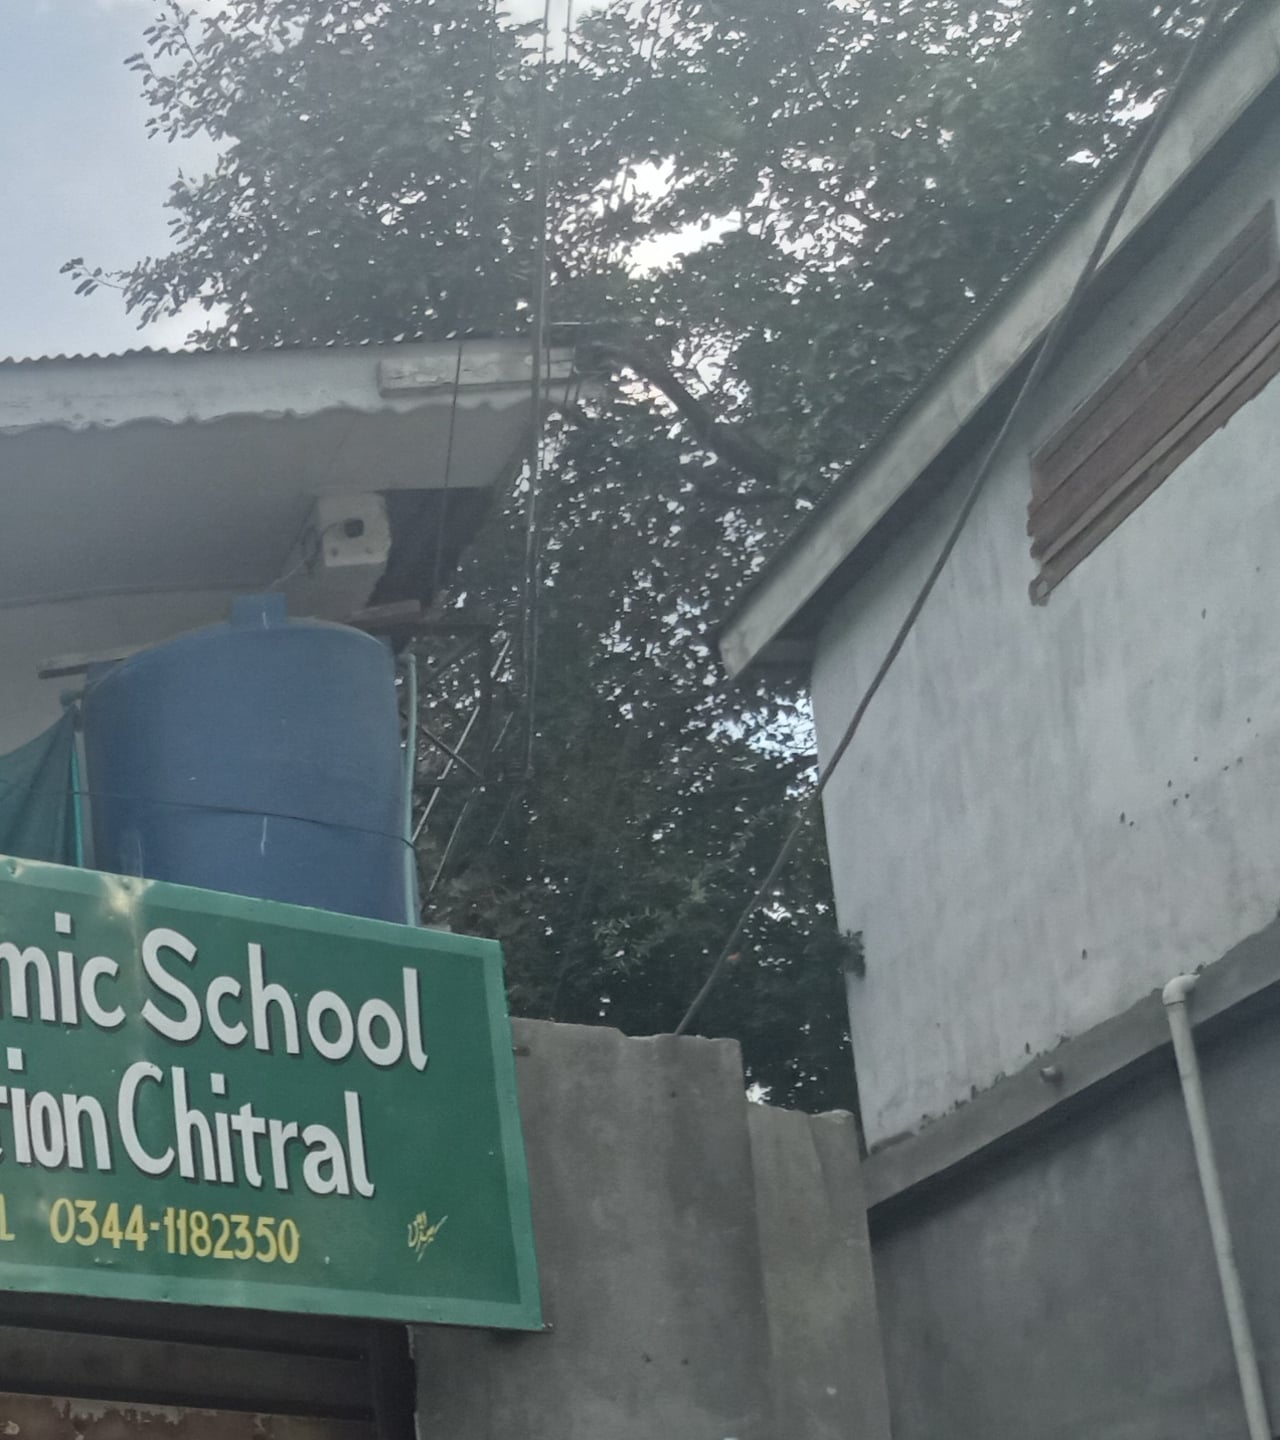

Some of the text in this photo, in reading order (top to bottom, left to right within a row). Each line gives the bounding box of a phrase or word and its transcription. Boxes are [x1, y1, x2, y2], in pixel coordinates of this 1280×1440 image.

[141, 928, 429, 1072] School
[118, 1062, 375, 1197] Chitral
[50, 1197, 301, 1264] 0344-1182350
